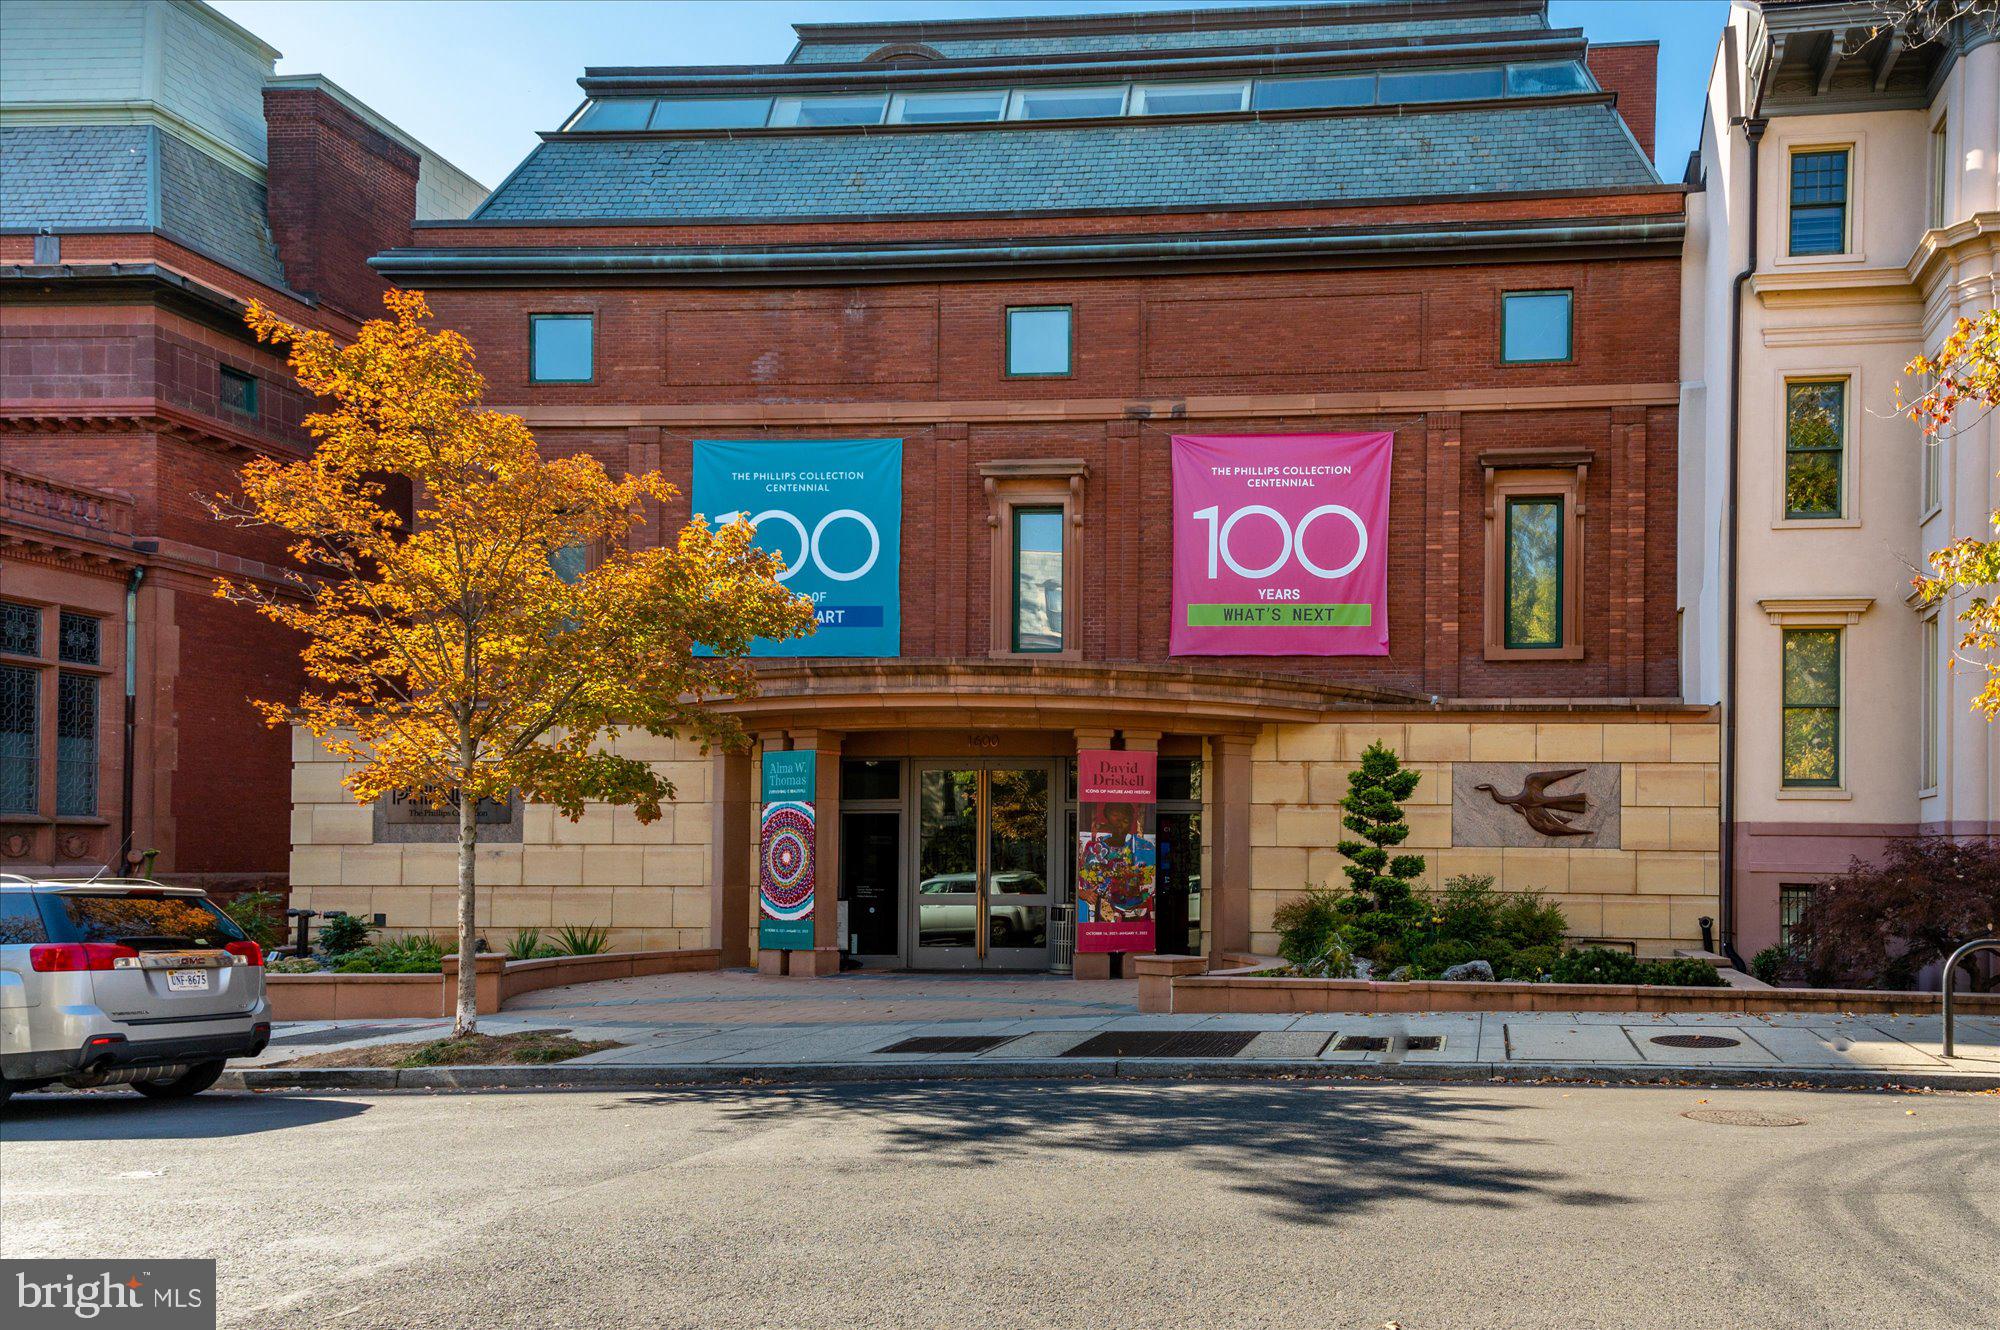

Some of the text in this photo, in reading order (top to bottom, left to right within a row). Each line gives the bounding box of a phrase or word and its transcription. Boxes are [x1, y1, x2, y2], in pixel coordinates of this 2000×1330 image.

[731, 471, 864, 480] THE PHILLIPS COLLECTION
[1211, 465, 1351, 475] THE PHILLIPS COLLECTION
[765, 483, 830, 492] CENTENNIAL
[1247, 478, 1315, 487] CENTENNIAL
[715, 509, 880, 581] 00
[1193, 504, 1368, 579] 100
[811, 591, 827, 603] OF
[1258, 588, 1300, 600] YEARS
[816, 610, 845, 624] ART
[1223, 607, 1334, 621] WHAT'S NEXT
[968, 734, 1000, 748] 1600
[769, 761, 807, 774] Alma W.
[1100, 760, 1138, 773] David
[769, 774, 807, 786] Thomas
[1093, 773, 1144, 786] Driskell
[409, 809, 424, 817] The
[181, 957, 206, 965] GMC
